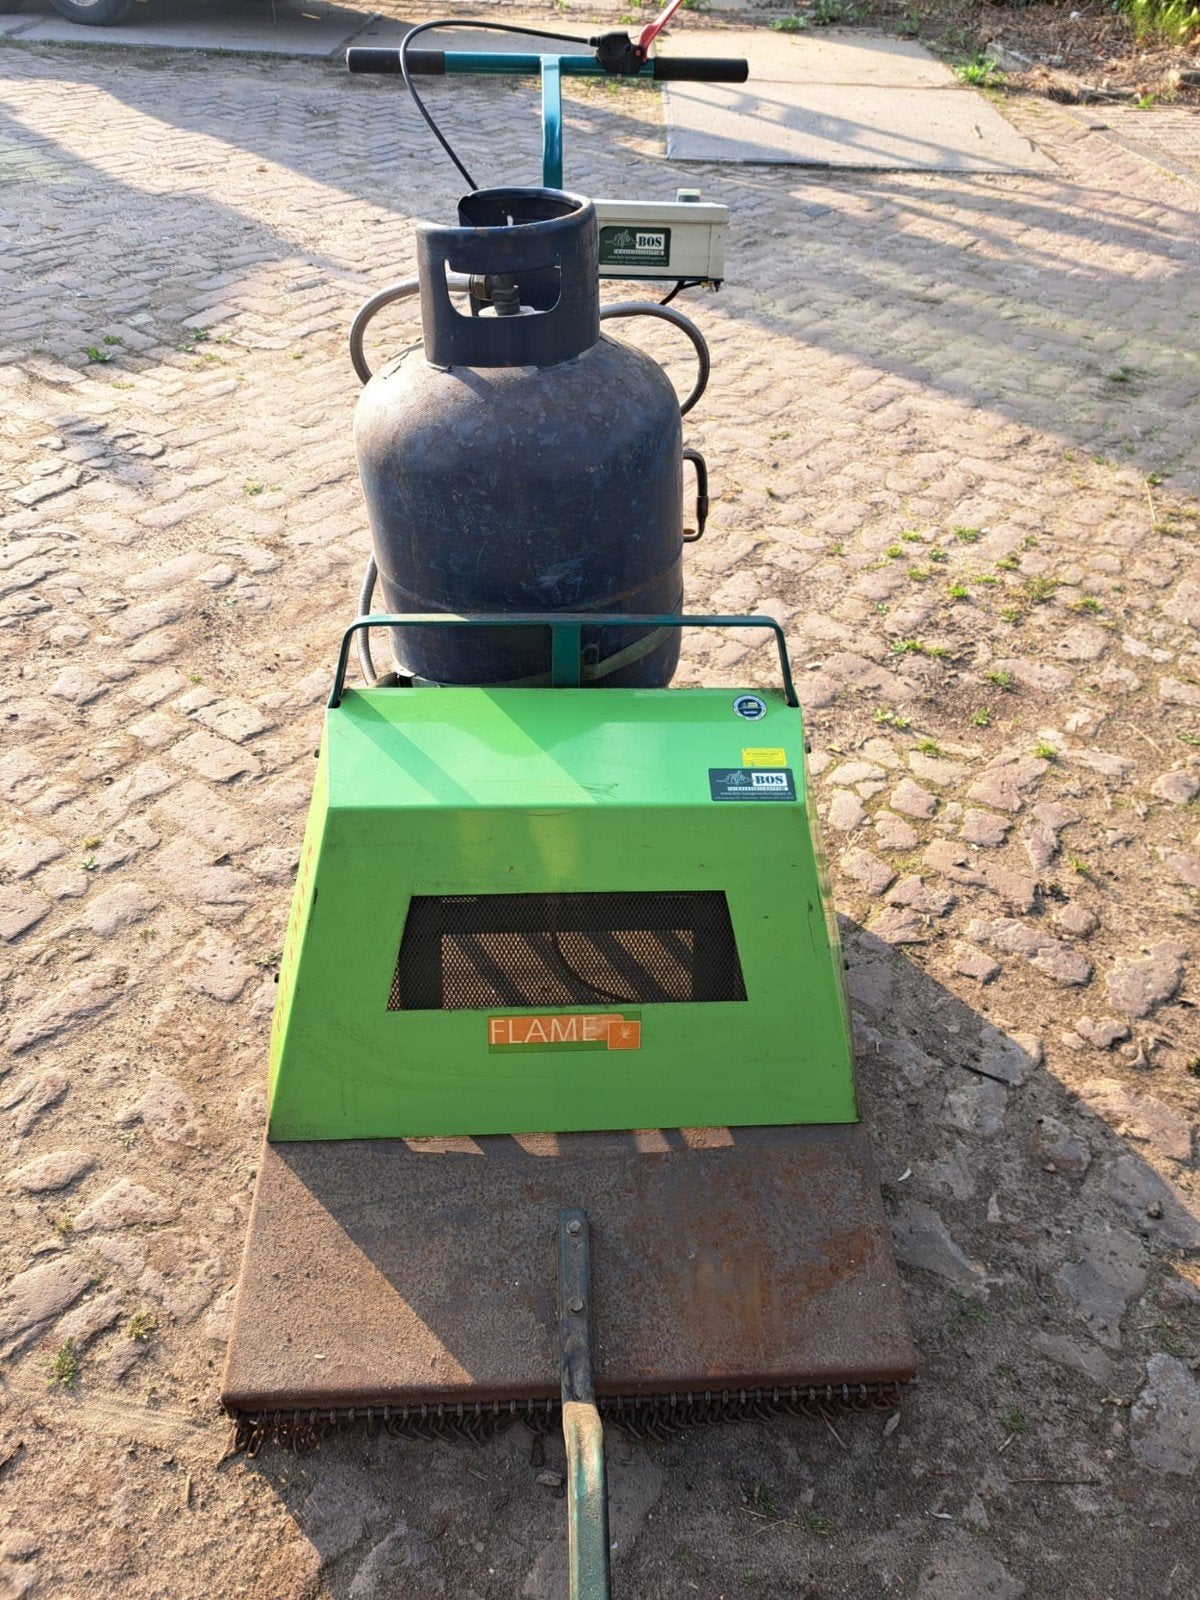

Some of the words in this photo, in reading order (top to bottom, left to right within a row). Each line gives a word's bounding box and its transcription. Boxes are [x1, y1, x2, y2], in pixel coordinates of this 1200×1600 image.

[638, 236, 662, 248] BOS
[755, 775, 784, 785] BOS
[491, 1017, 598, 1045] FLAME
